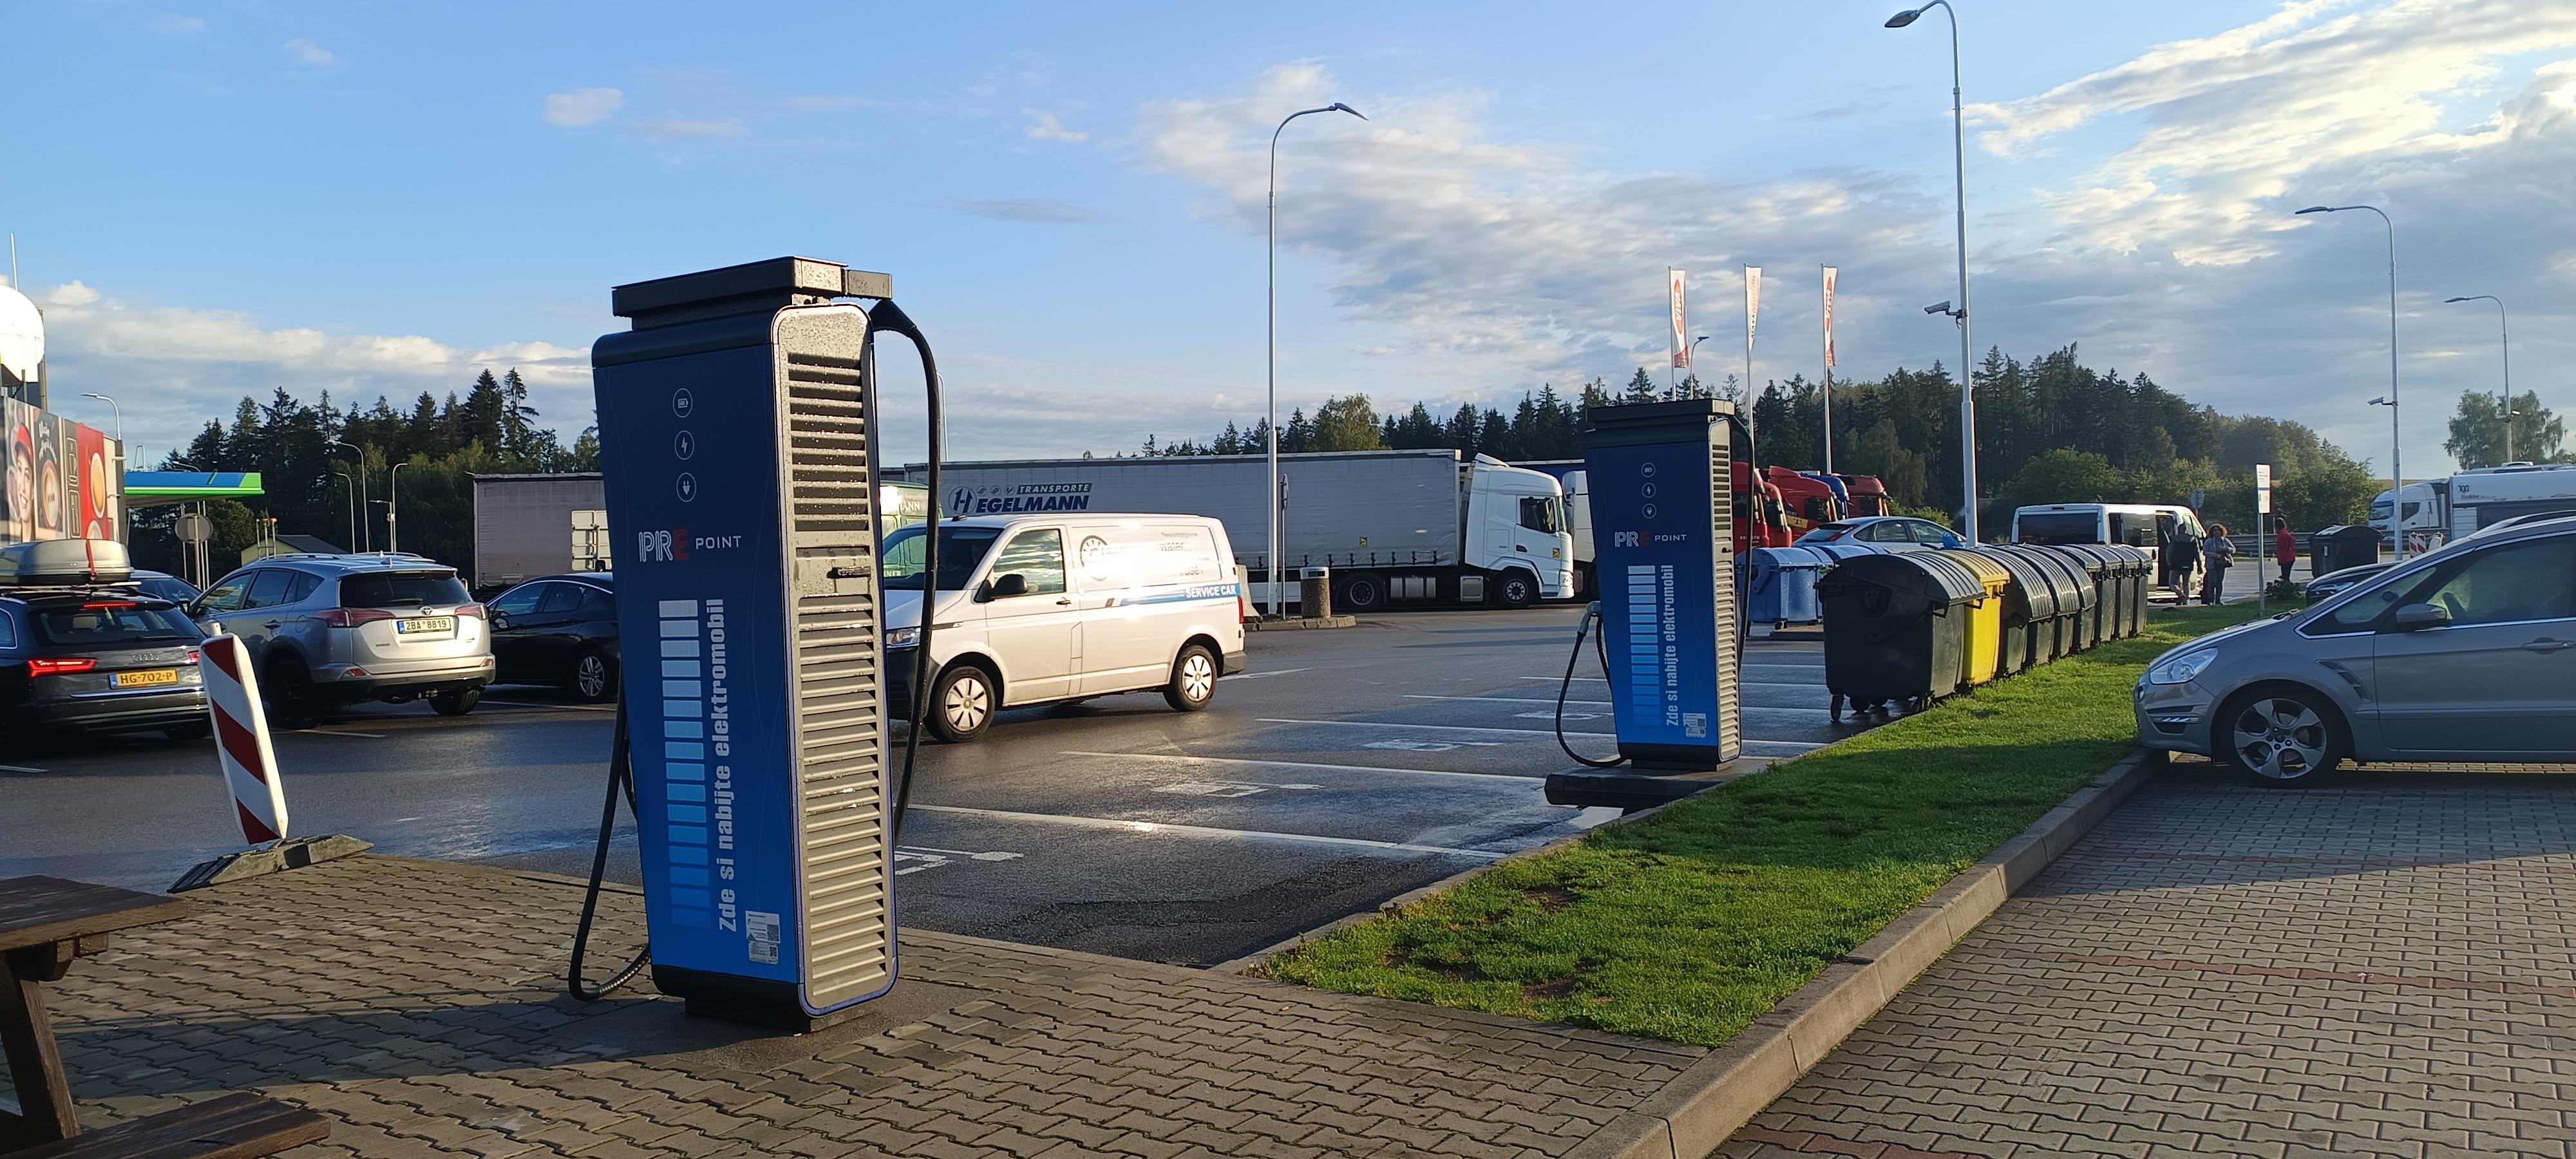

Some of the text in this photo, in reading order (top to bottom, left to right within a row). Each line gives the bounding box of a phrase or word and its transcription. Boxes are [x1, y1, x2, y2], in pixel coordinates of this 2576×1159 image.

[1674, 291, 1683, 321] VIVA
[1019, 484, 1089, 493] TRANSPORTE
[952, 487, 1089, 514] HEGELMANN
[639, 529, 741, 562] PRE POINT
[1615, 531, 1649, 547] PRE
[1186, 585, 1236, 598] SERVICE CAR
[406, 620, 446, 630] 2BA 8819
[1661, 565, 1678, 726] Zde si nabijte elektromobil
[120, 672, 173, 684] HG-702-P
[706, 599, 736, 932] Zde si nabijte elektromobil
